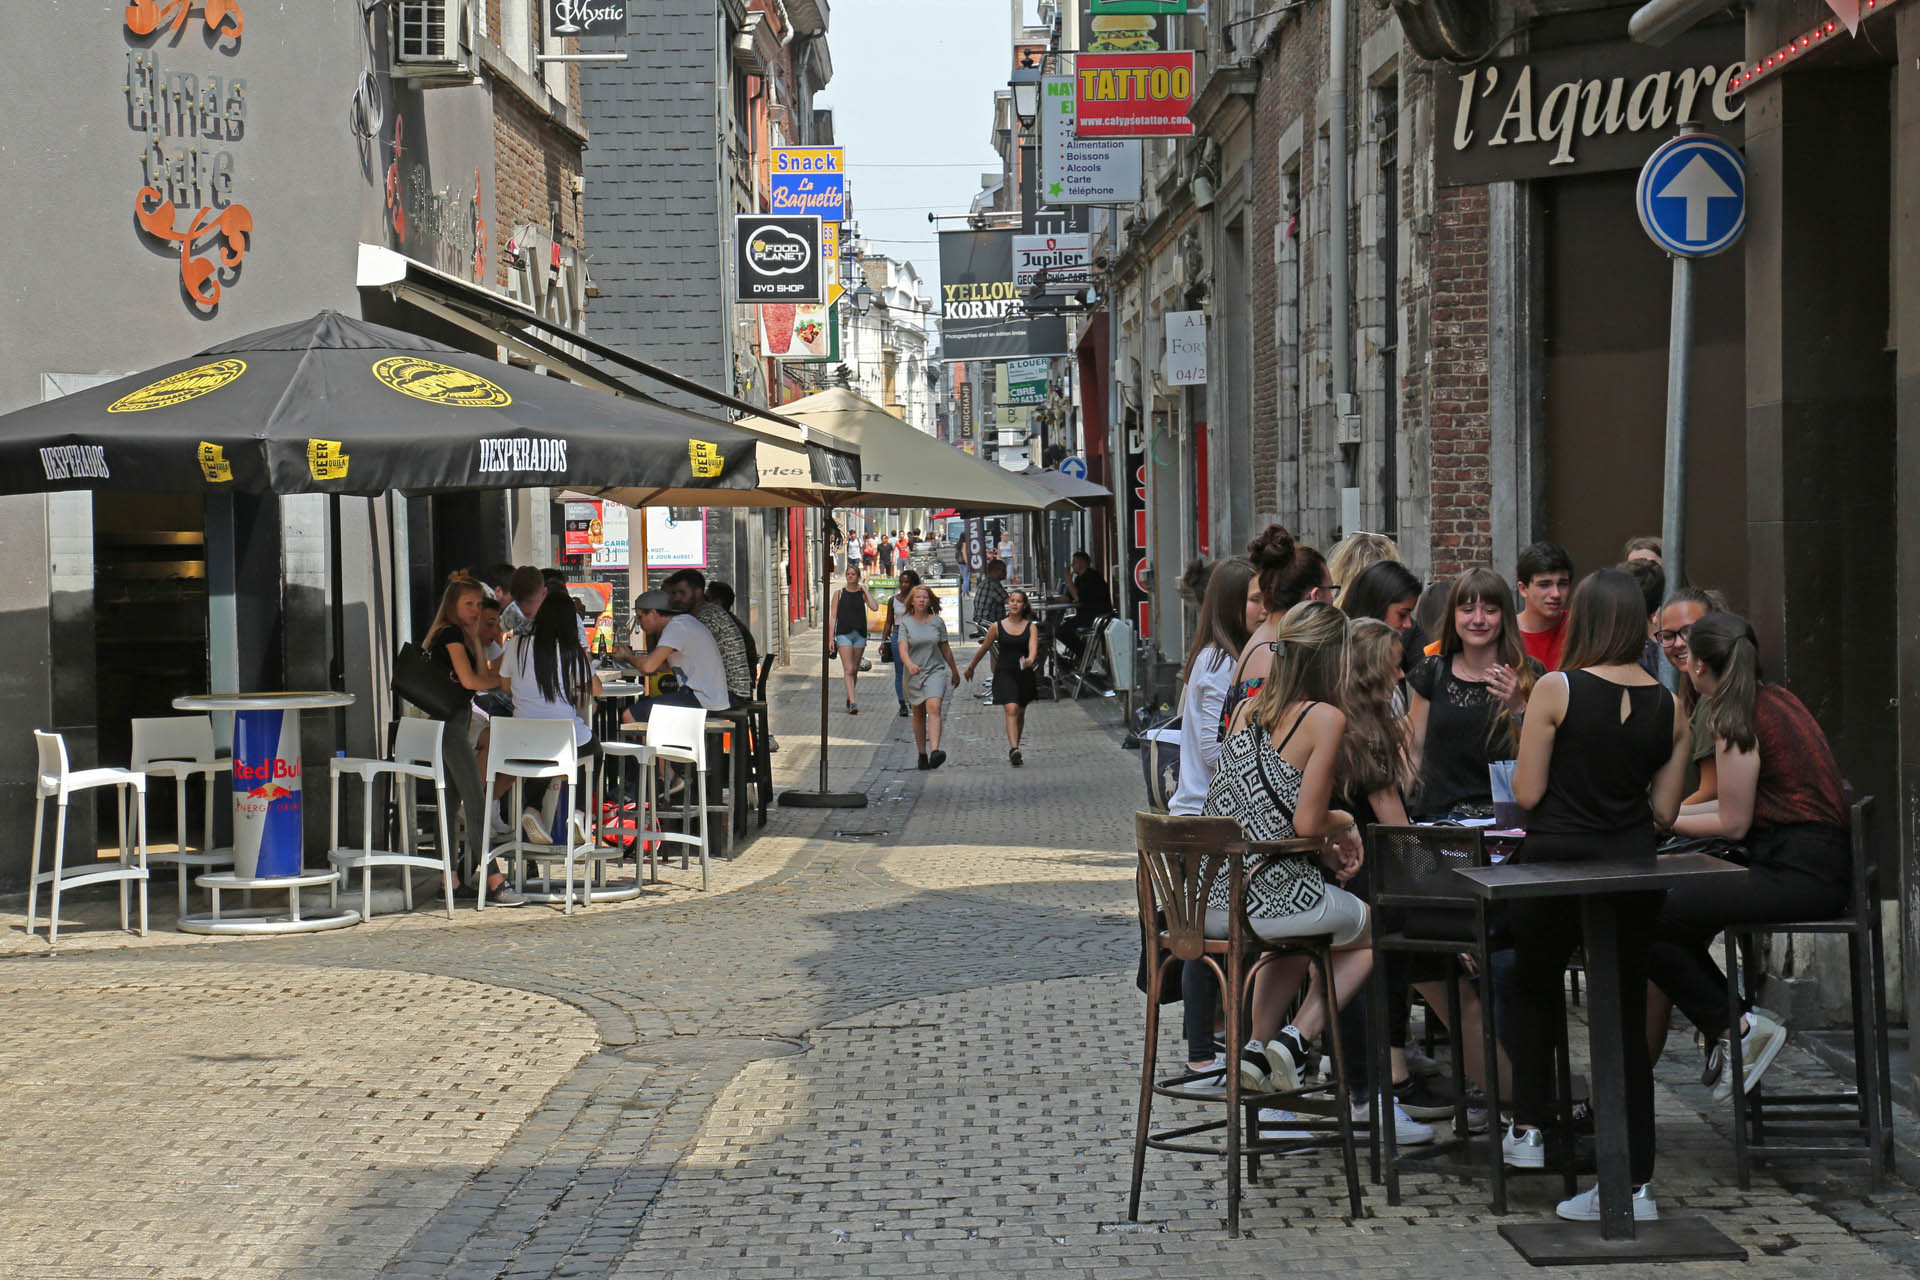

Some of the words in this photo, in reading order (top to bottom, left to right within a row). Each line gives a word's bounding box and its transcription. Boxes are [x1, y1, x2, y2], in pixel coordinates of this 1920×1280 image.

[556, 0, 623, 30] Mystic
[1079, 66, 1191, 100] TATTOO
[1079, 116, 1191, 127] www.calypsotattoo.com
[1066, 141, 1124, 149] Alimentation
[777, 153, 837, 171] Snack
[1066, 153, 1109, 161] Boissons
[1066, 164, 1101, 172] Alcools
[798, 177, 814, 191] La
[754, 252, 804, 261] PLANET
[765, 244, 799, 253] FOOD
[1022, 251, 1083, 268] Jupiler
[753, 284, 775, 293] DVD
[776, 284, 805, 293] SHOP
[1017, 359, 1047, 369] LOUER
[962, 385, 971, 437] LONGCHAMP
[40, 445, 110, 480] DESPERADOS
[204, 446, 218, 479] BEER
[316, 443, 328, 476] BEER
[480, 437, 567, 473] DESPERADOS
[696, 443, 709, 474] BEER
[234, 757, 270, 780] Red
